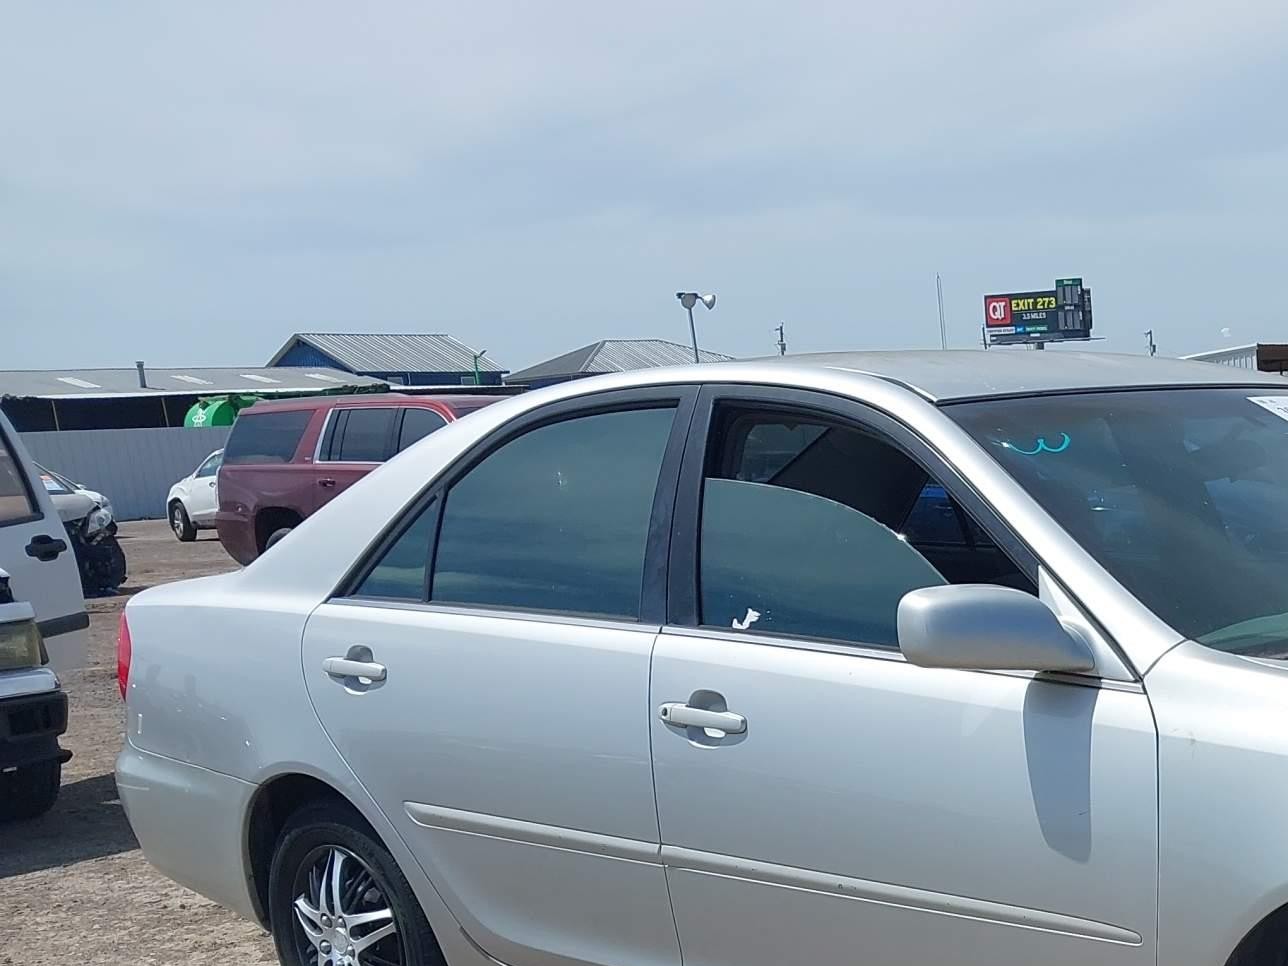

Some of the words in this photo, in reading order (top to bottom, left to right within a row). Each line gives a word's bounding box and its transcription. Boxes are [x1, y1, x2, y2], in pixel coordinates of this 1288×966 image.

[989, 301, 1006, 320] QT
[1011, 299, 1033, 311] EXIT
[1036, 297, 1056, 309] 273
[1031, 311, 1047, 319] MILES
